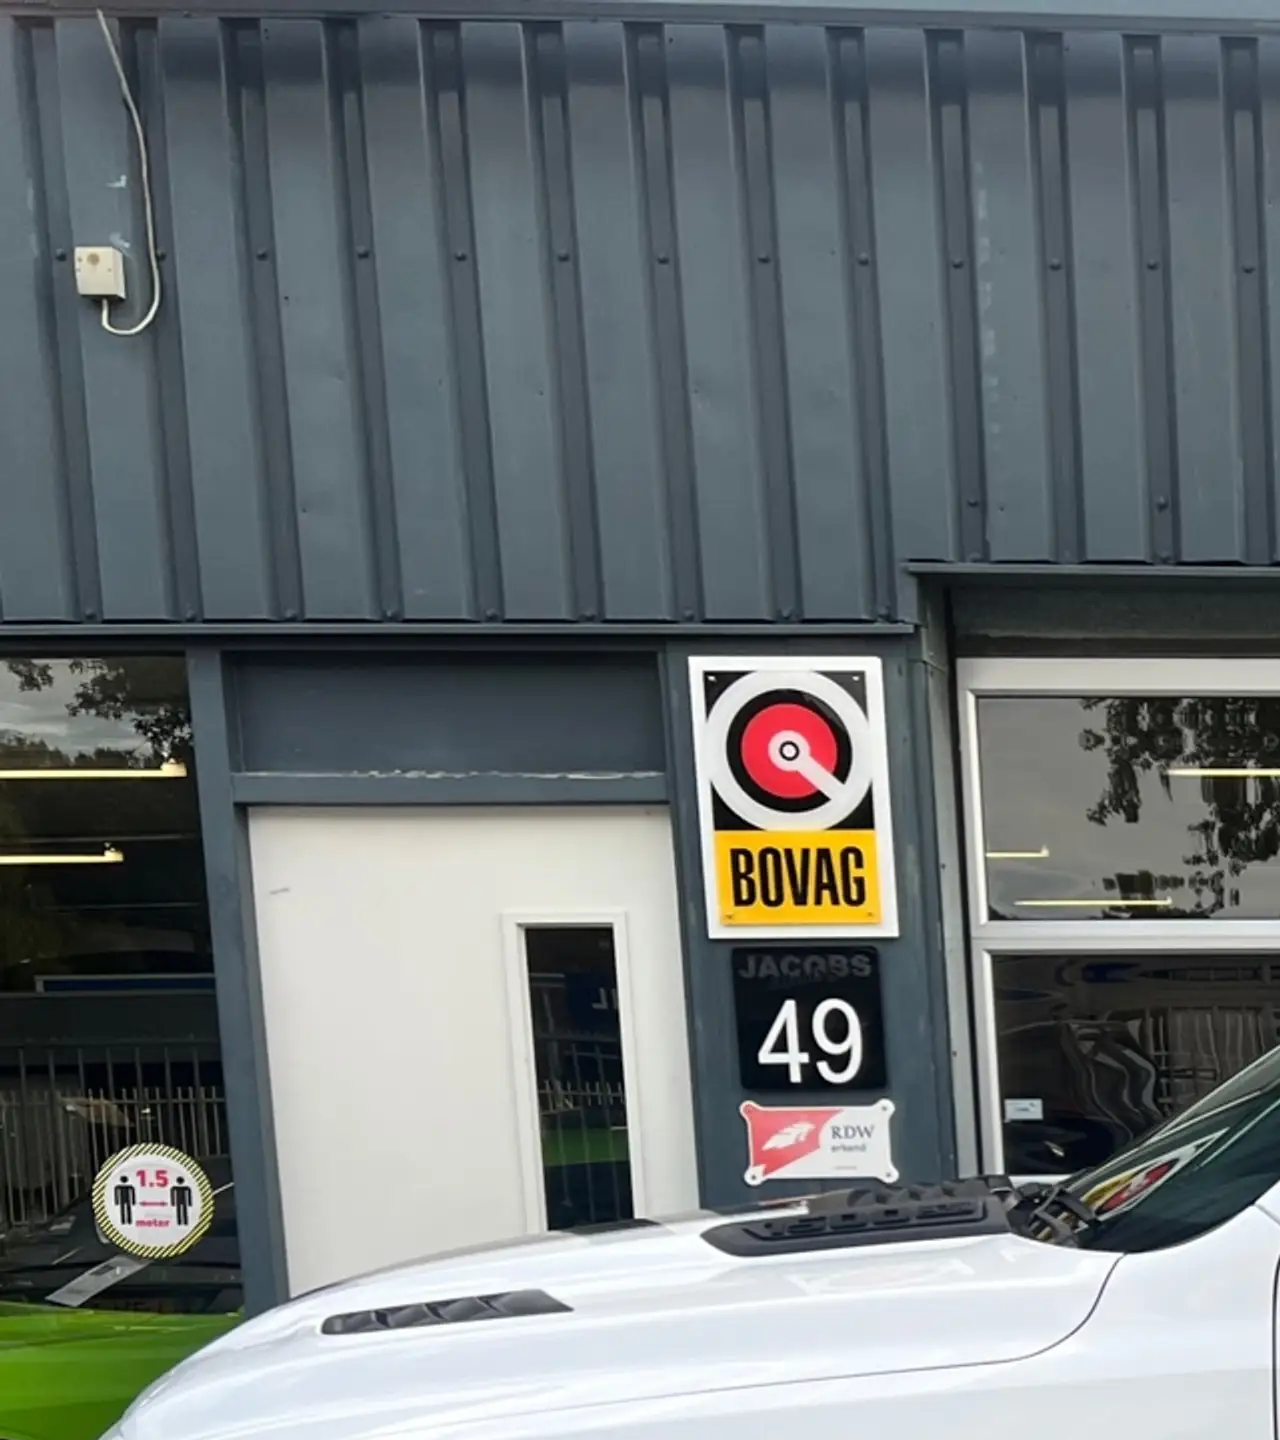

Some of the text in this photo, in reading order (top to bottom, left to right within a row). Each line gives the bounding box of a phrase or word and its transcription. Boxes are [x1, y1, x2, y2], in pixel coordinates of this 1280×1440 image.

[729, 846, 867, 908] BOVAG
[737, 954, 873, 979] JACOBS
[757, 997, 864, 1085] 49
[830, 1125, 875, 1140] RDW
[135, 1169, 169, 1188] 1.5
[135, 1219, 170, 1228] meter
